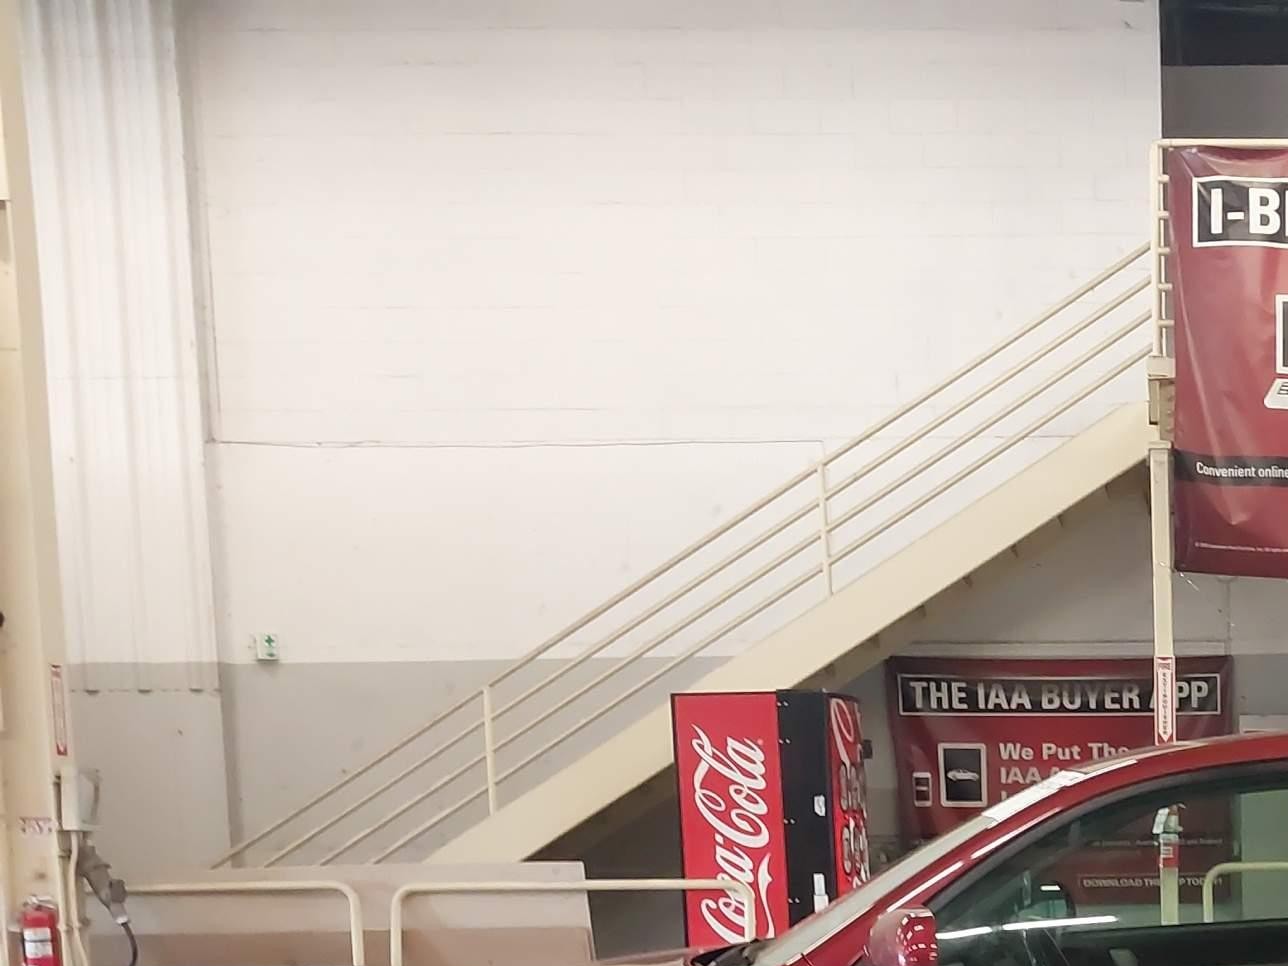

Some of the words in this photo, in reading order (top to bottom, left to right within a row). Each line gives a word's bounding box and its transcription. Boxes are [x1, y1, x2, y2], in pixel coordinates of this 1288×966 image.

[1195, 461, 1256, 478] Convenient
[909, 681, 969, 710] THE
[976, 681, 1032, 711] IAA
[1041, 680, 1141, 710] BUYER
[999, 742, 1034, 761] We
[1042, 742, 1082, 761] Put
[1000, 766, 1043, 785] IAA
